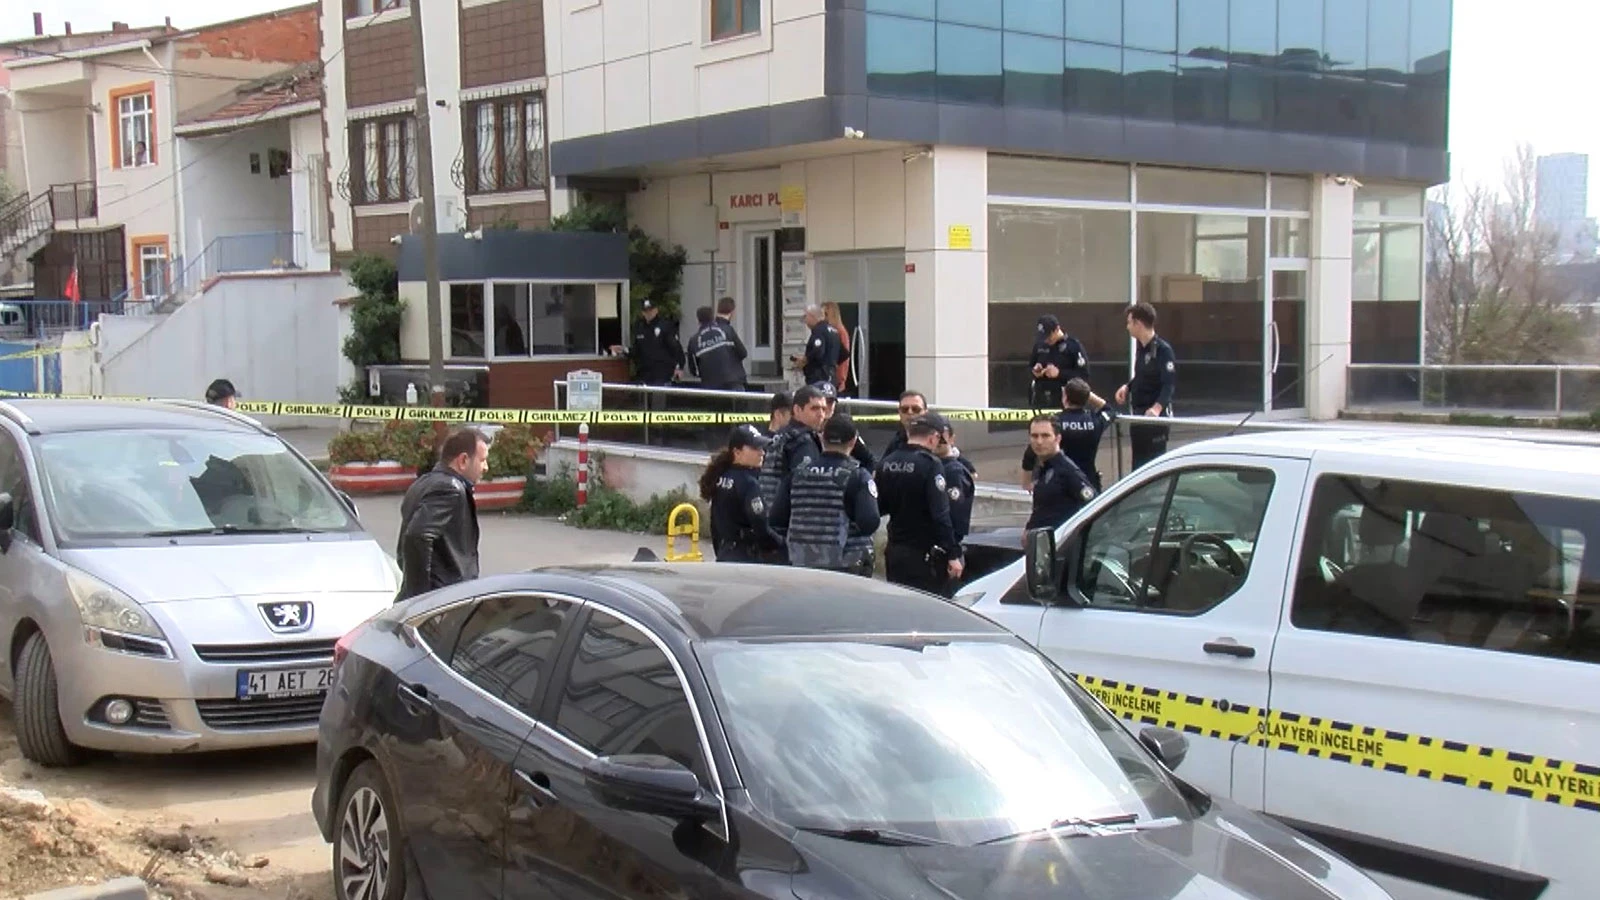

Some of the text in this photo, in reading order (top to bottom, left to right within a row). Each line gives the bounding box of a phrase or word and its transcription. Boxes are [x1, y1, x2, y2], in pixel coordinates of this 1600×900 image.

[250, 674, 267, 692] 41
[278, 671, 306, 690] AET
[1112, 693, 1161, 715] İNCELEME
[1257, 721, 1384, 757] OLAY YERİ İNCELEME
[1513, 767, 1594, 797] OLAY YERİ
